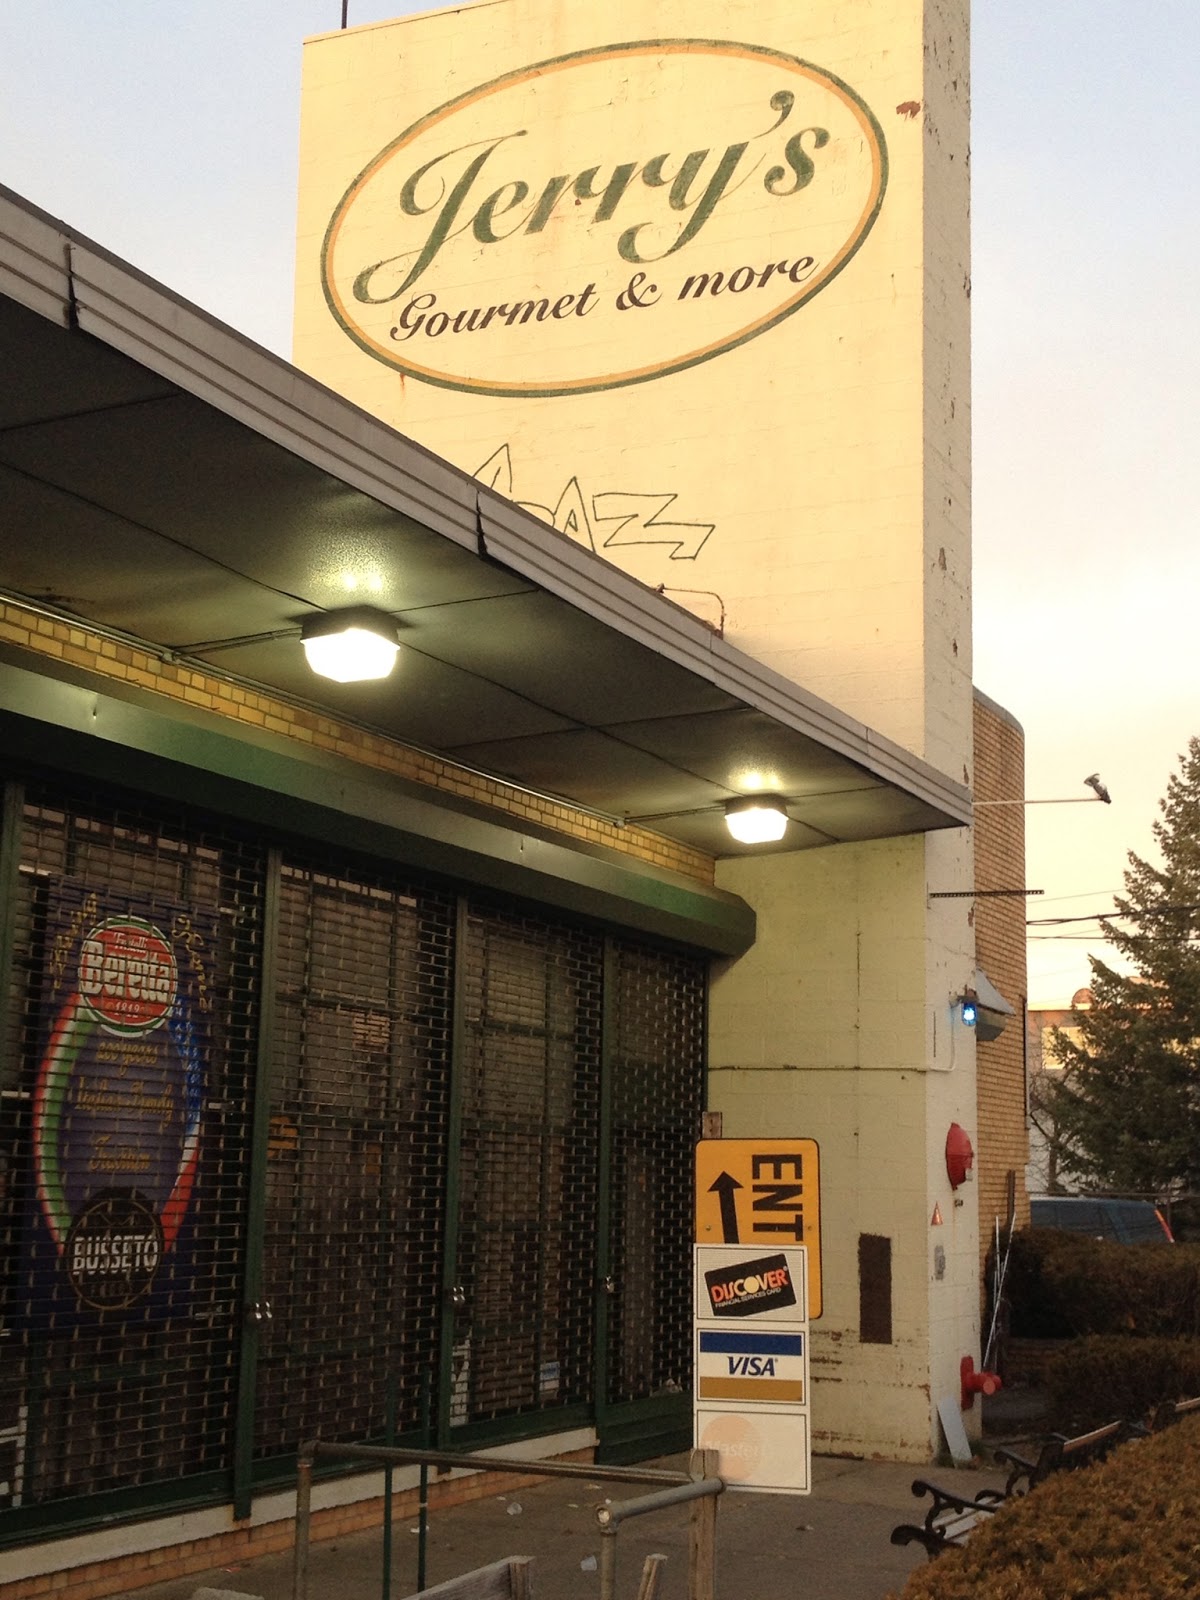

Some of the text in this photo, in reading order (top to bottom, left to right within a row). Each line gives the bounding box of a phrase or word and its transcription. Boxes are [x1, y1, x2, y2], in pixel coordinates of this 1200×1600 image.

[352, 89, 831, 304] Jerry's
[389, 255, 820, 342] Gourmet & more
[72, 1234, 159, 1275] BUSSETO
[711, 1268, 789, 1303] DISCOVER
[727, 1356, 775, 1377] VISA
